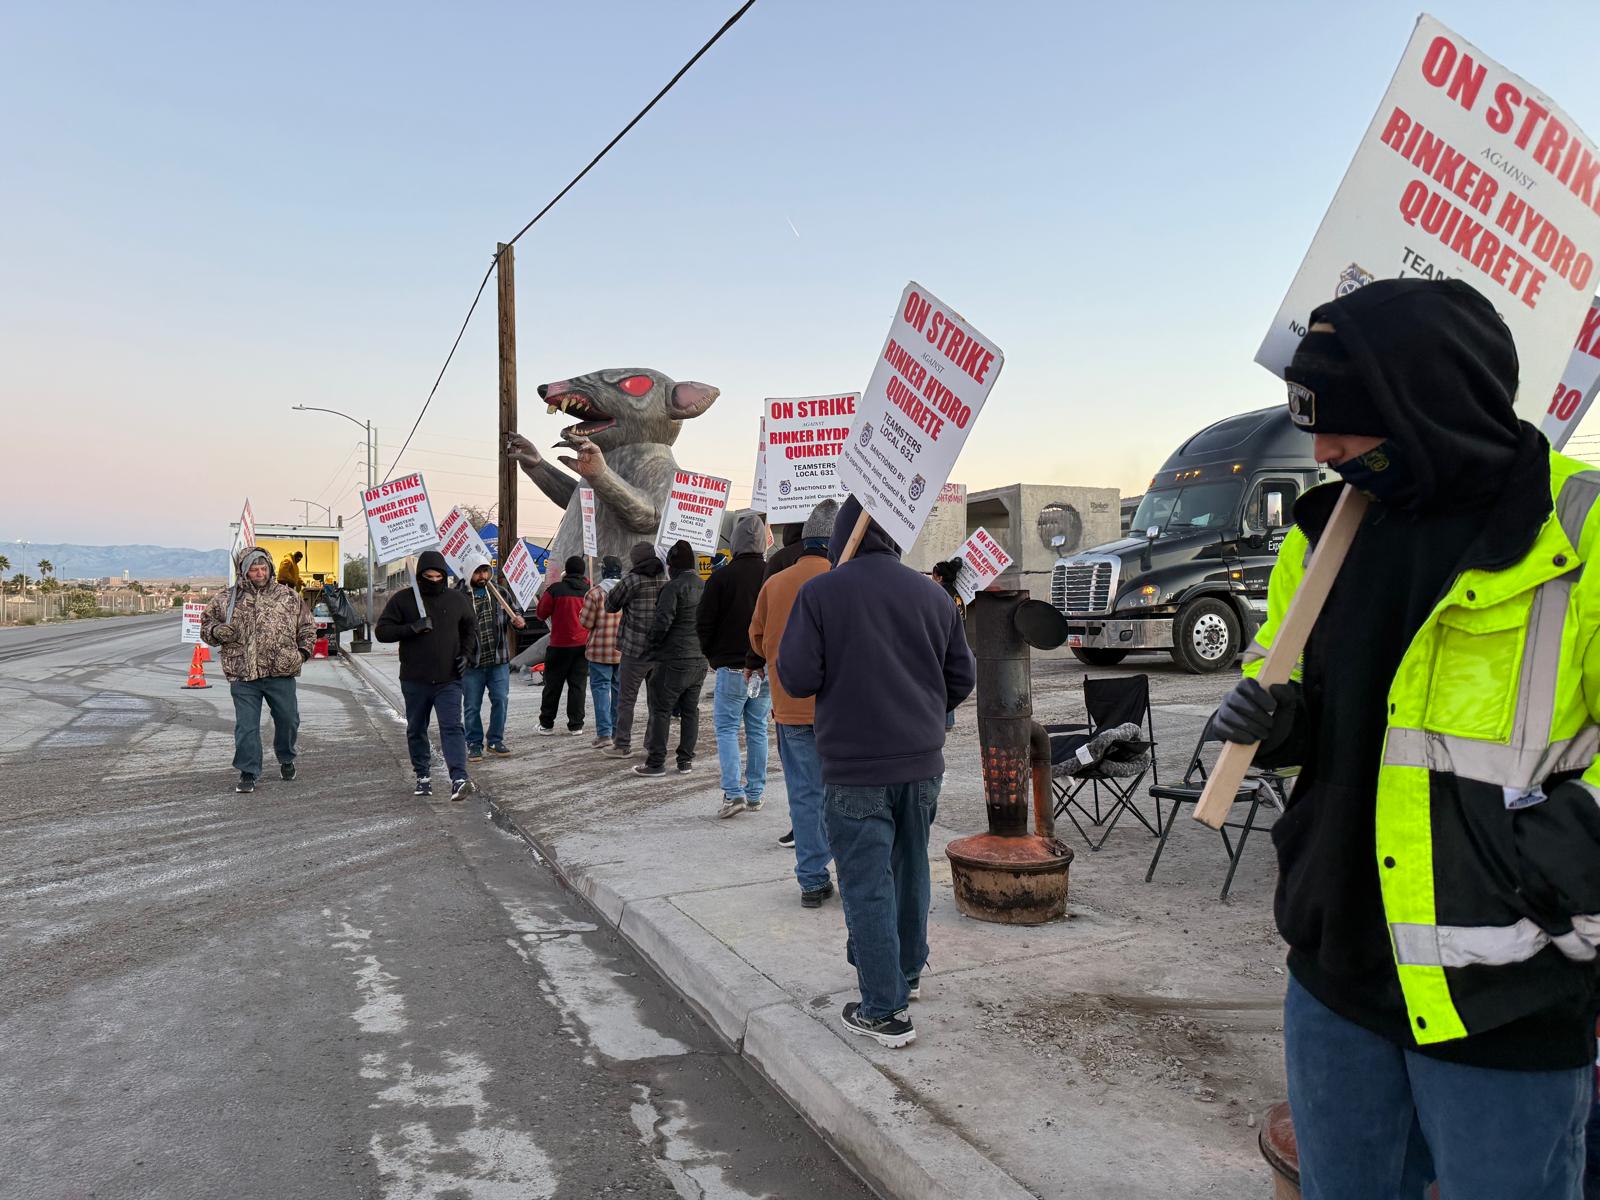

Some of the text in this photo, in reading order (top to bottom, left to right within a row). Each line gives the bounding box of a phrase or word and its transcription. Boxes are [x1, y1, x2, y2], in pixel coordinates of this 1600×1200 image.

[1421, 35, 1600, 218] ON STRIK
[1480, 147, 1537, 191] AGAINST
[1380, 106, 1594, 291] RINKER HYDRO
[1399, 179, 1548, 310] QUIKRETE
[904, 291, 994, 384] ON STRIKE
[921, 353, 945, 374] AGAINST
[883, 338, 971, 429] RINKER HYDRO
[771, 396, 856, 420] ON STRIKE
[886, 375, 945, 442] QUIKRETE
[770, 427, 850, 445] RINKER HYDR
[880, 424, 915, 463] LOCAL 631
[883, 411, 922, 454] TEAMSTERS
[794, 463, 836, 471] TEAMSTERS
[796, 470, 818, 478] LOCAL
[853, 443, 916, 514] Teamsters Joint Council No. 42
[869, 444, 907, 486] SANCTIONED BY:
[365, 489, 380, 502] ON
[382, 475, 420, 496] STRIKE
[671, 490, 725, 509] RINKER HYDRO
[691, 475, 727, 493] STRIKE
[862, 472, 872, 487] WITH
[871, 484, 880, 495] ANY
[880, 493, 893, 509] OTHER
[892, 506, 916, 531] EMPLOYER
[368, 501, 397, 517] RINKER
[398, 493, 425, 507] HYDRO
[379, 505, 418, 523] QUIKRETE
[440, 509, 460, 536] STRIKE
[678, 503, 713, 516] QUIKRETE
[976, 531, 1009, 566] ON STRIKE
